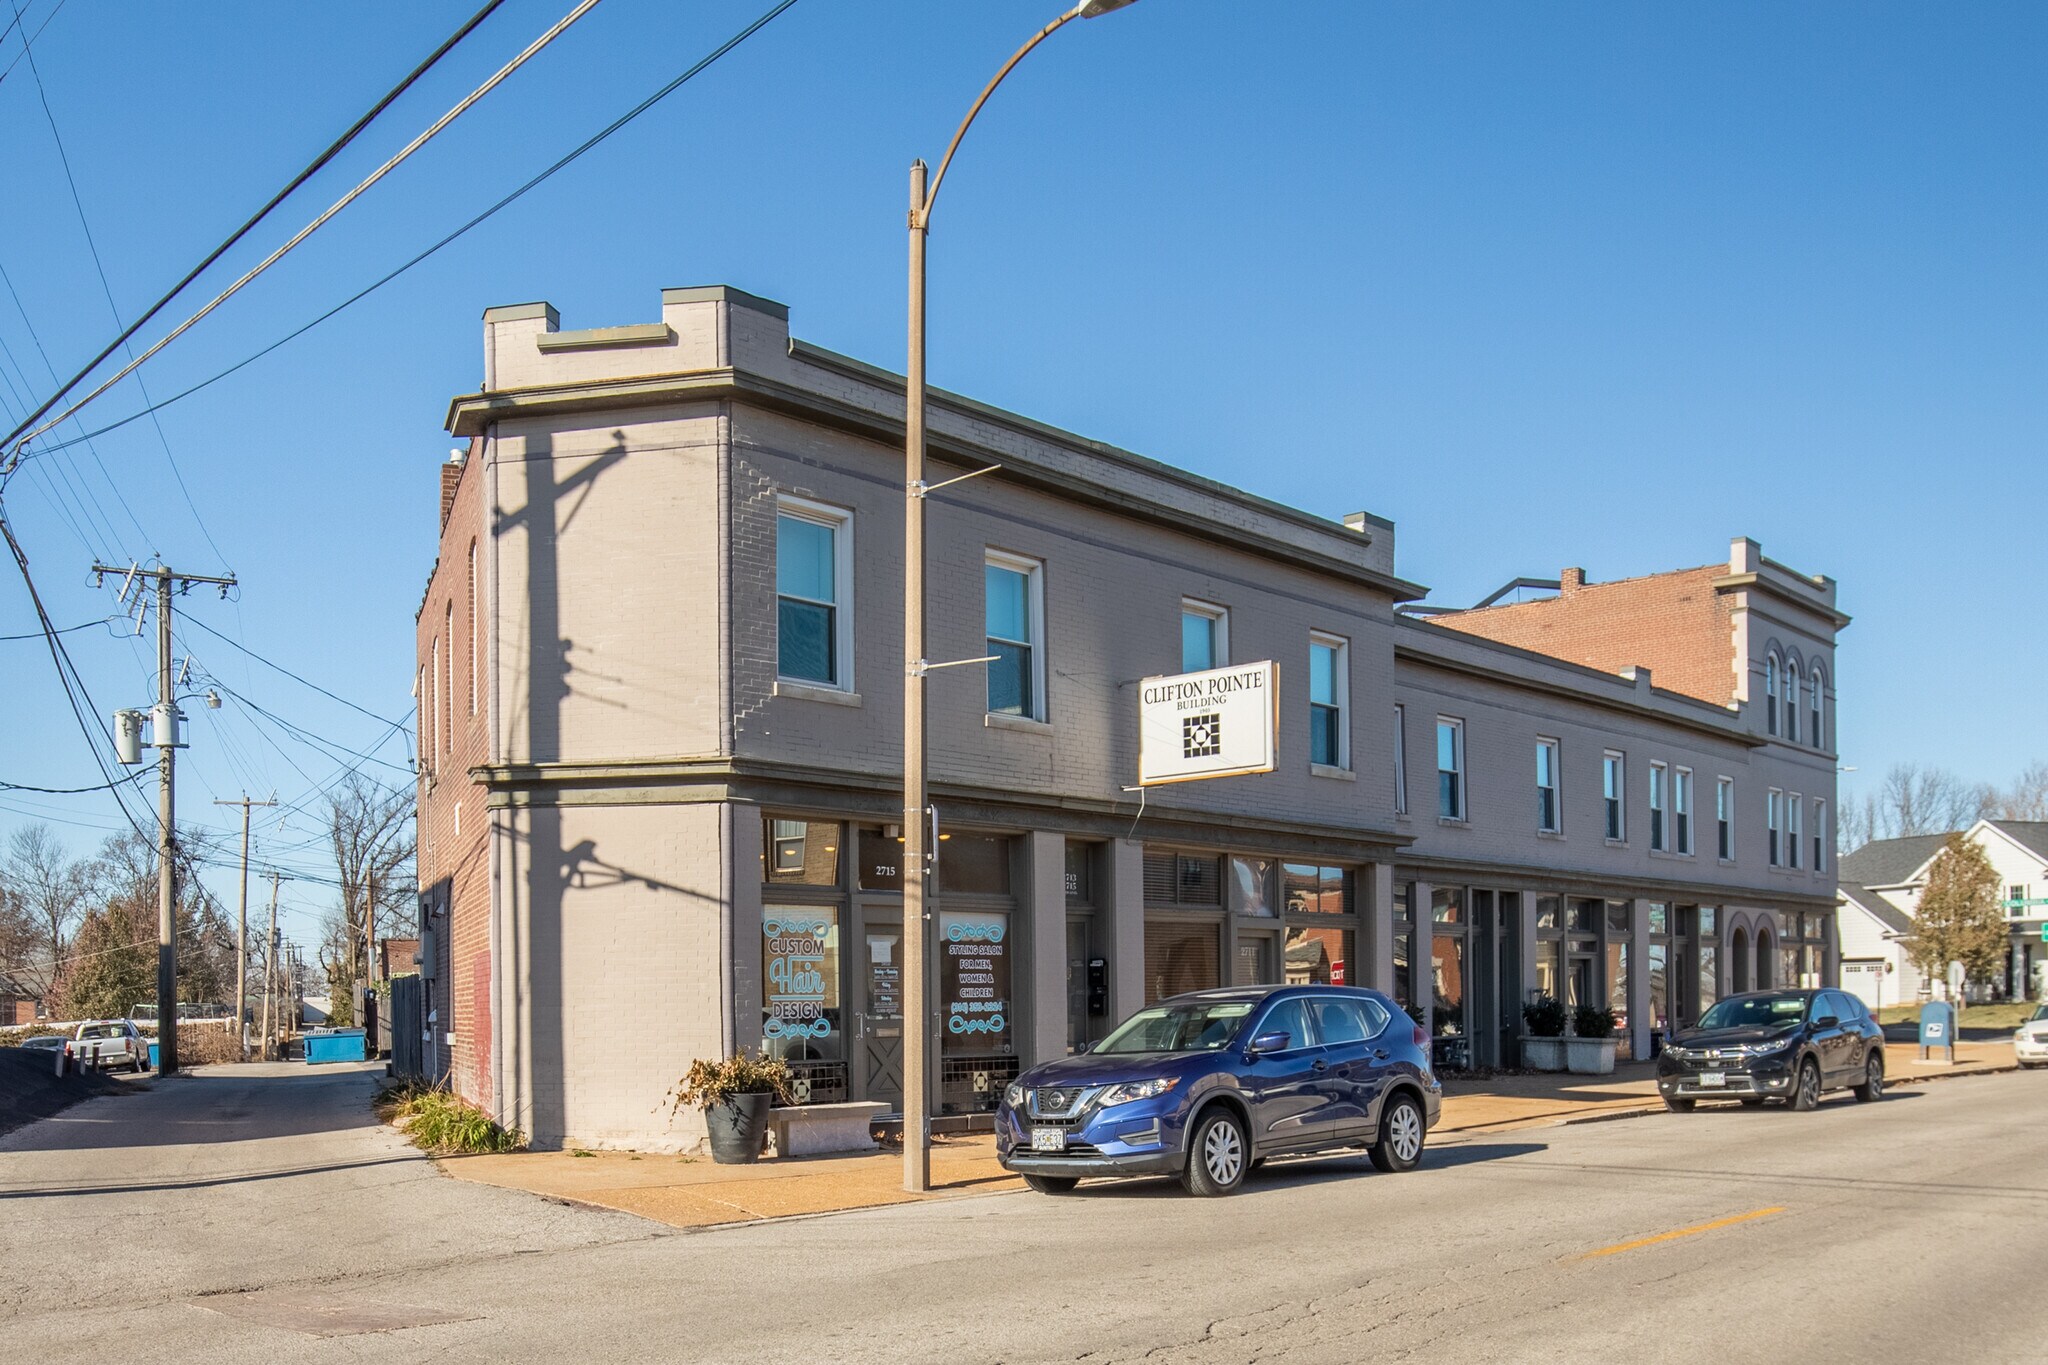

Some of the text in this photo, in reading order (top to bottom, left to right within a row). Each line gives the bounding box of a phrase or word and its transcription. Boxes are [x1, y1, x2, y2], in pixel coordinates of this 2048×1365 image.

[1144, 671, 1263, 705] CLIFTON POINTE
[1177, 694, 1227, 711] BUILDING
[875, 866, 896, 876] 2715
[768, 938, 826, 955] CUSTOM
[948, 944, 1003, 956] STYLING SALON
[960, 959, 993, 970] FOR MEN,
[769, 957, 826, 993] Hair
[959, 973, 995, 984] WOMEN &
[960, 987, 994, 998] CHILDREN
[773, 1001, 823, 1019] DESIGN
